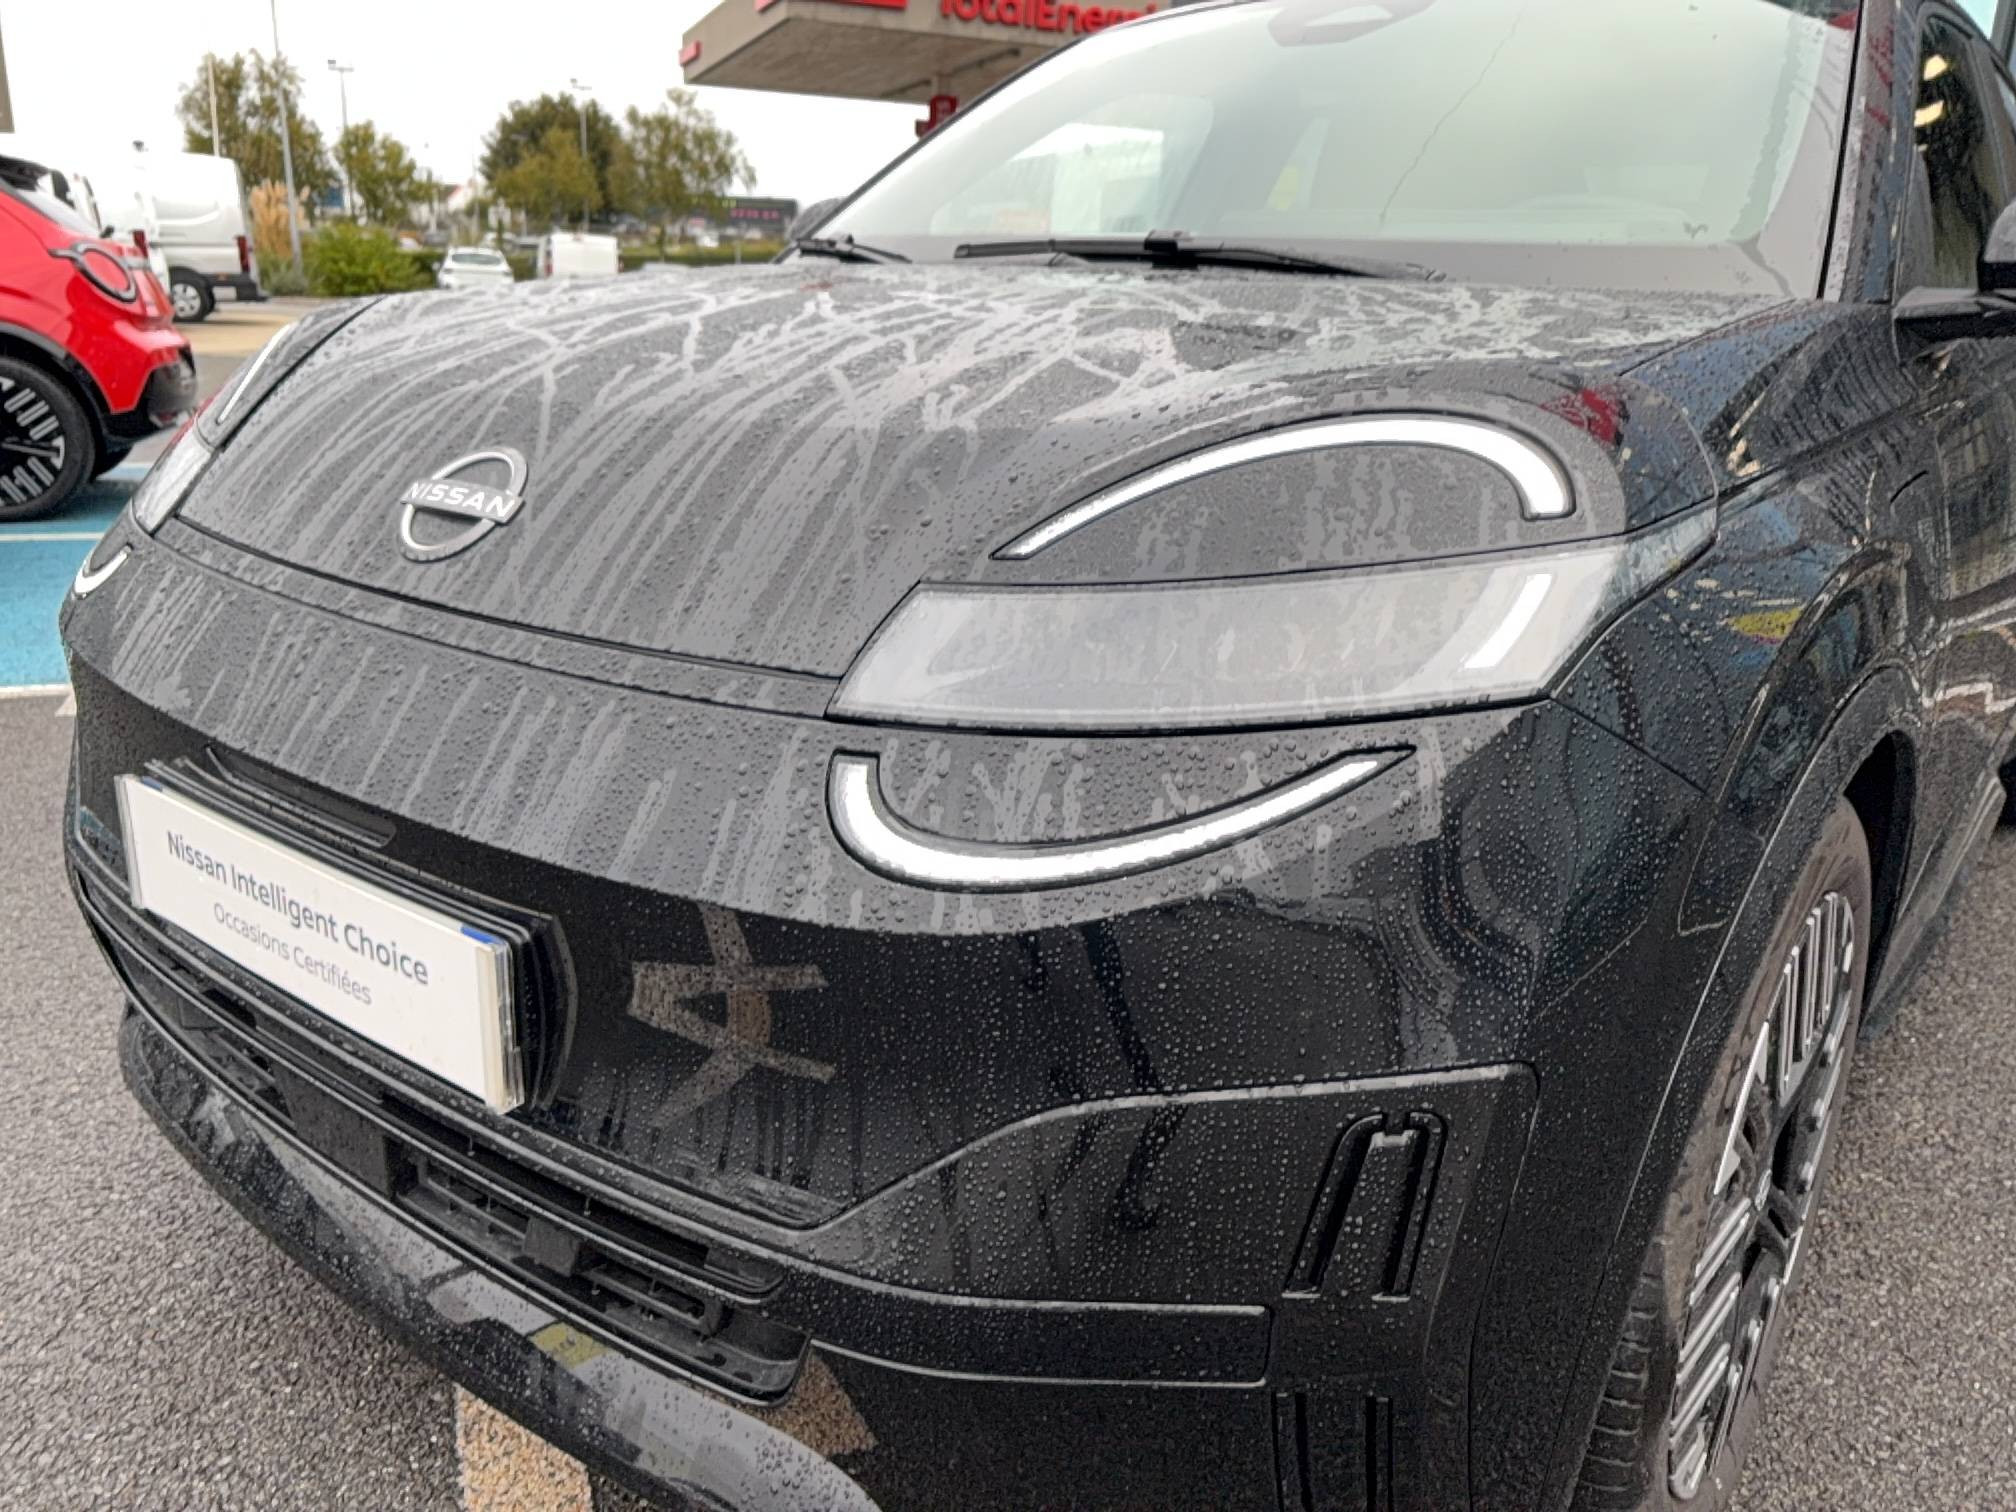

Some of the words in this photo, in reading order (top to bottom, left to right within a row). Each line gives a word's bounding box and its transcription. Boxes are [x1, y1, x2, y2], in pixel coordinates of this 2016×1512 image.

[938, 0, 1157, 34] otalEner
[408, 482, 515, 518] NISSAN
[167, 829, 228, 885] Nissan
[231, 863, 339, 943] Intelligent
[343, 923, 429, 985] Choice
[214, 902, 290, 961] Occasions
[293, 945, 373, 1006] Certifiées
